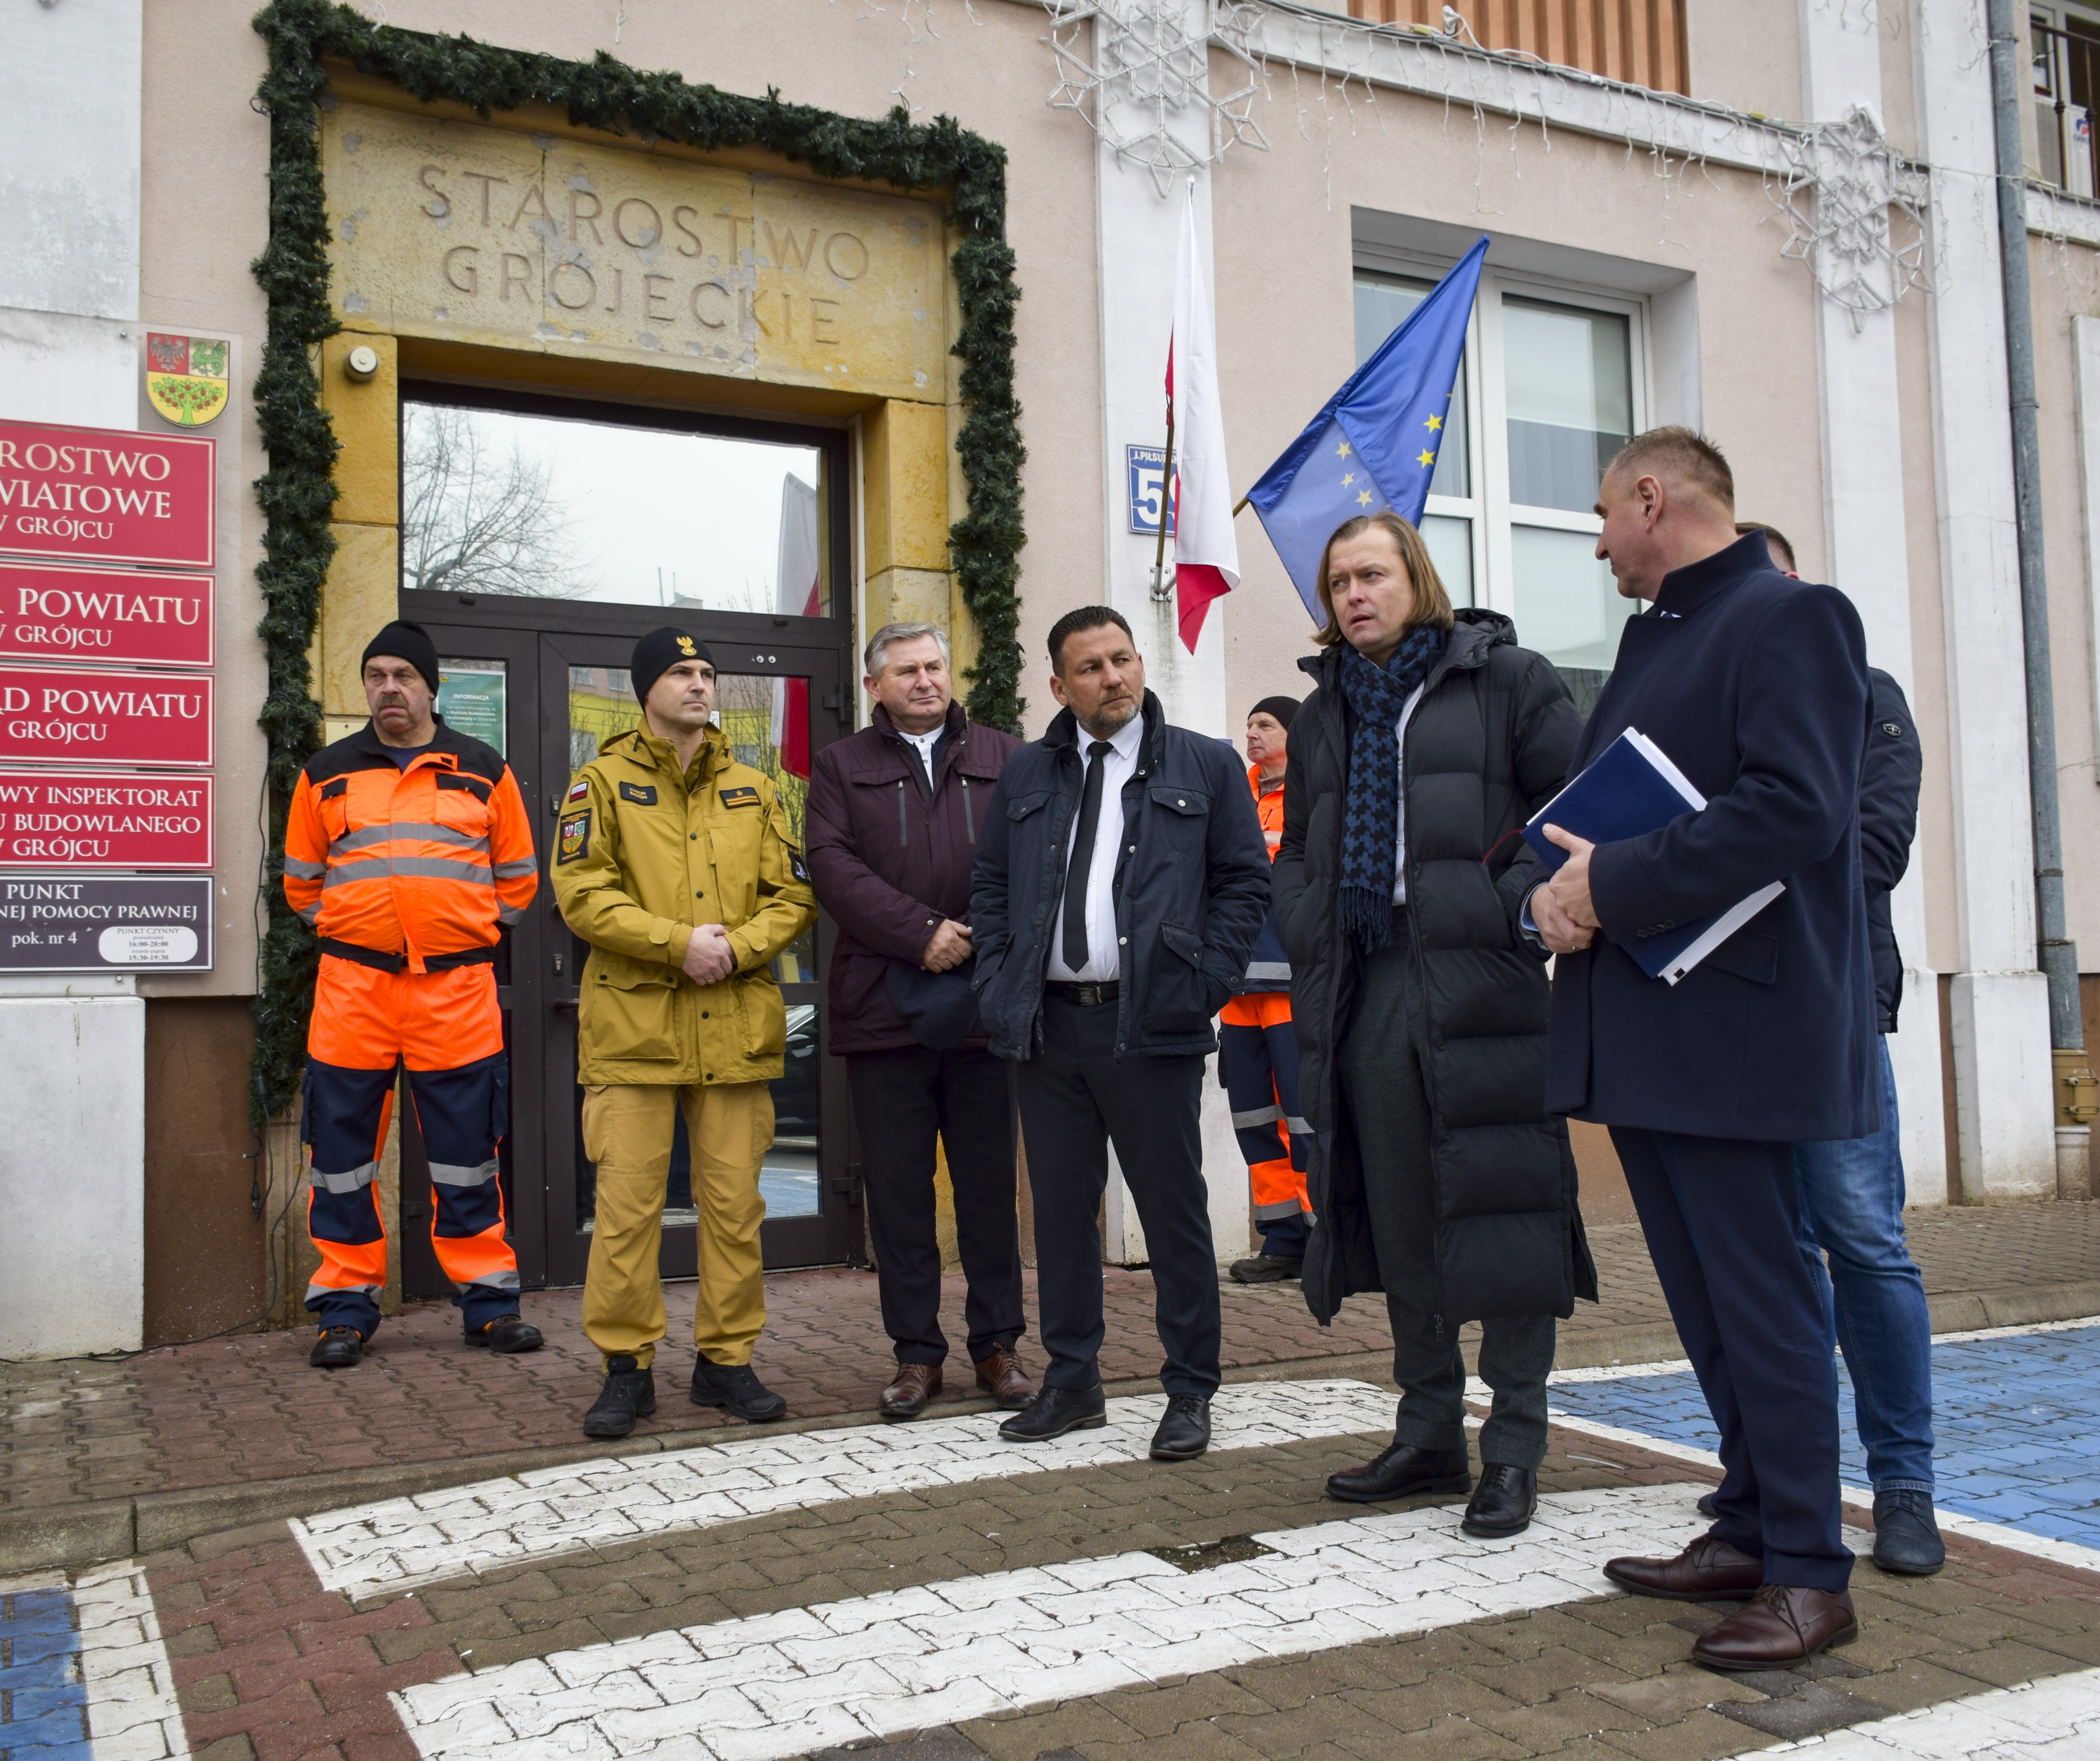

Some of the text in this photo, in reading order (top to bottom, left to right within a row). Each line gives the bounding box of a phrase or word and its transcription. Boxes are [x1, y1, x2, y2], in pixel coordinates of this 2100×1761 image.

[419, 165, 870, 280] STAROSTWO
[443, 246, 841, 346] GRÓJECKIE
[16, 516, 114, 542] GRÓJCU
[18, 588, 201, 625] POWIATU
[15, 623, 113, 649] GRÓJCU
[43, 689, 202, 719] POWIATU
[8, 718, 107, 744] GRÓJCU
[47, 787, 202, 807] INSPEKTORAT
[15, 814, 201, 834] BUDOWLANEGO
[13, 836, 110, 861] GRÓJCU
[7, 884, 84, 900] PUNKT
[32, 905, 113, 919] POMOCY
[117, 905, 198, 921] PRAWNEJ
[11, 932, 77, 947] pok. nr 4
